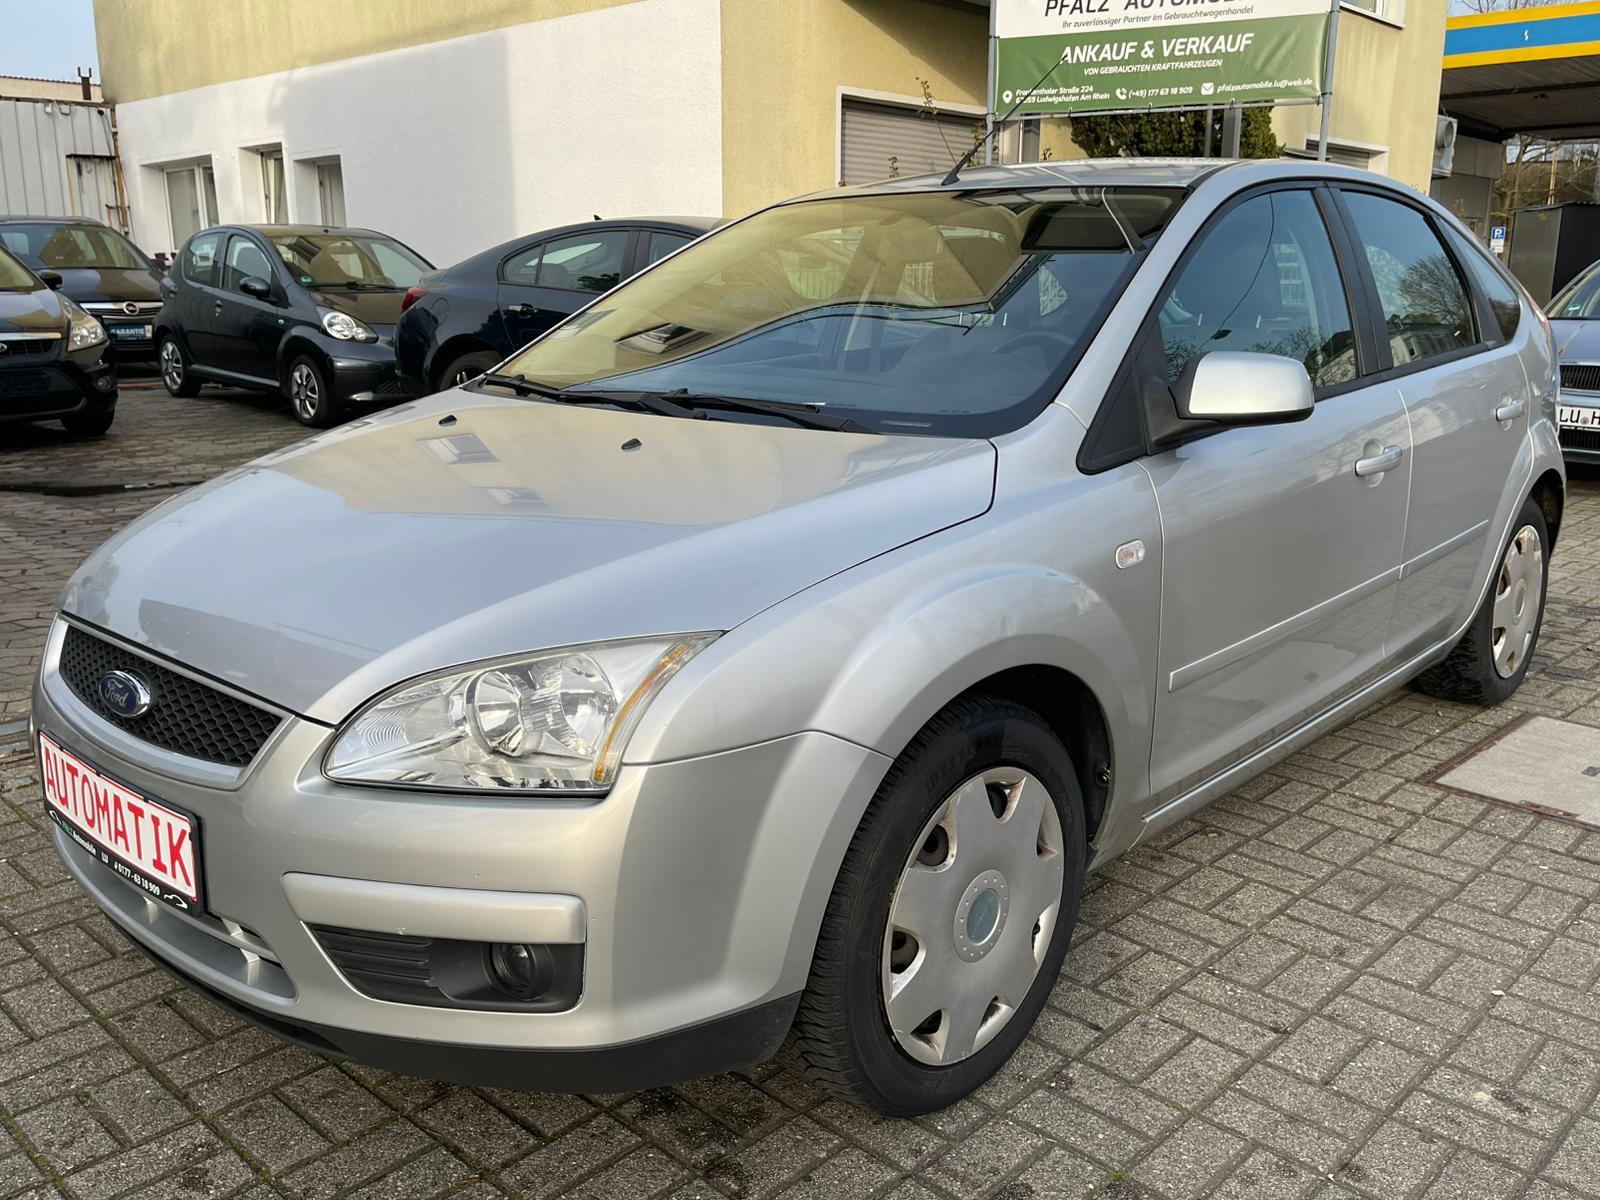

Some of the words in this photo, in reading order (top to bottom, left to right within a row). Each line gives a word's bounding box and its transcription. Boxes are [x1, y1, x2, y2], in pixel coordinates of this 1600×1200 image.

[1044, 0, 1110, 17] PFALZ
[1123, 14, 1152, 23] Partner
[1164, 5, 1254, 20] Gebrauchtwagenhandel
[1059, 41, 1138, 64] ANKAUF
[1140, 40, 1155, 59] &
[1161, 32, 1255, 57] VERKAUF
[1084, 66, 1099, 76] VON
[1099, 63, 1151, 74] GEBRAUCHTEN
[1151, 59, 1223, 71] KRAFTFAHRZEUGEN
[1036, 93, 1080, 104] Ludwigshafen
[1092, 92, 1110, 100] Rhein
[1058, 86, 1080, 94] Straße
[1080, 85, 1094, 93] 224
[1128, 89, 1147, 99] (+49)
[1148, 88, 1159, 97] 177
[1159, 87, 1169, 96] 63
[1170, 86, 1178, 95] 18
[1178, 86, 1193, 94] 909
[1560, 408, 1580, 424] LU
[45, 746, 191, 887] AUTOMATIK
